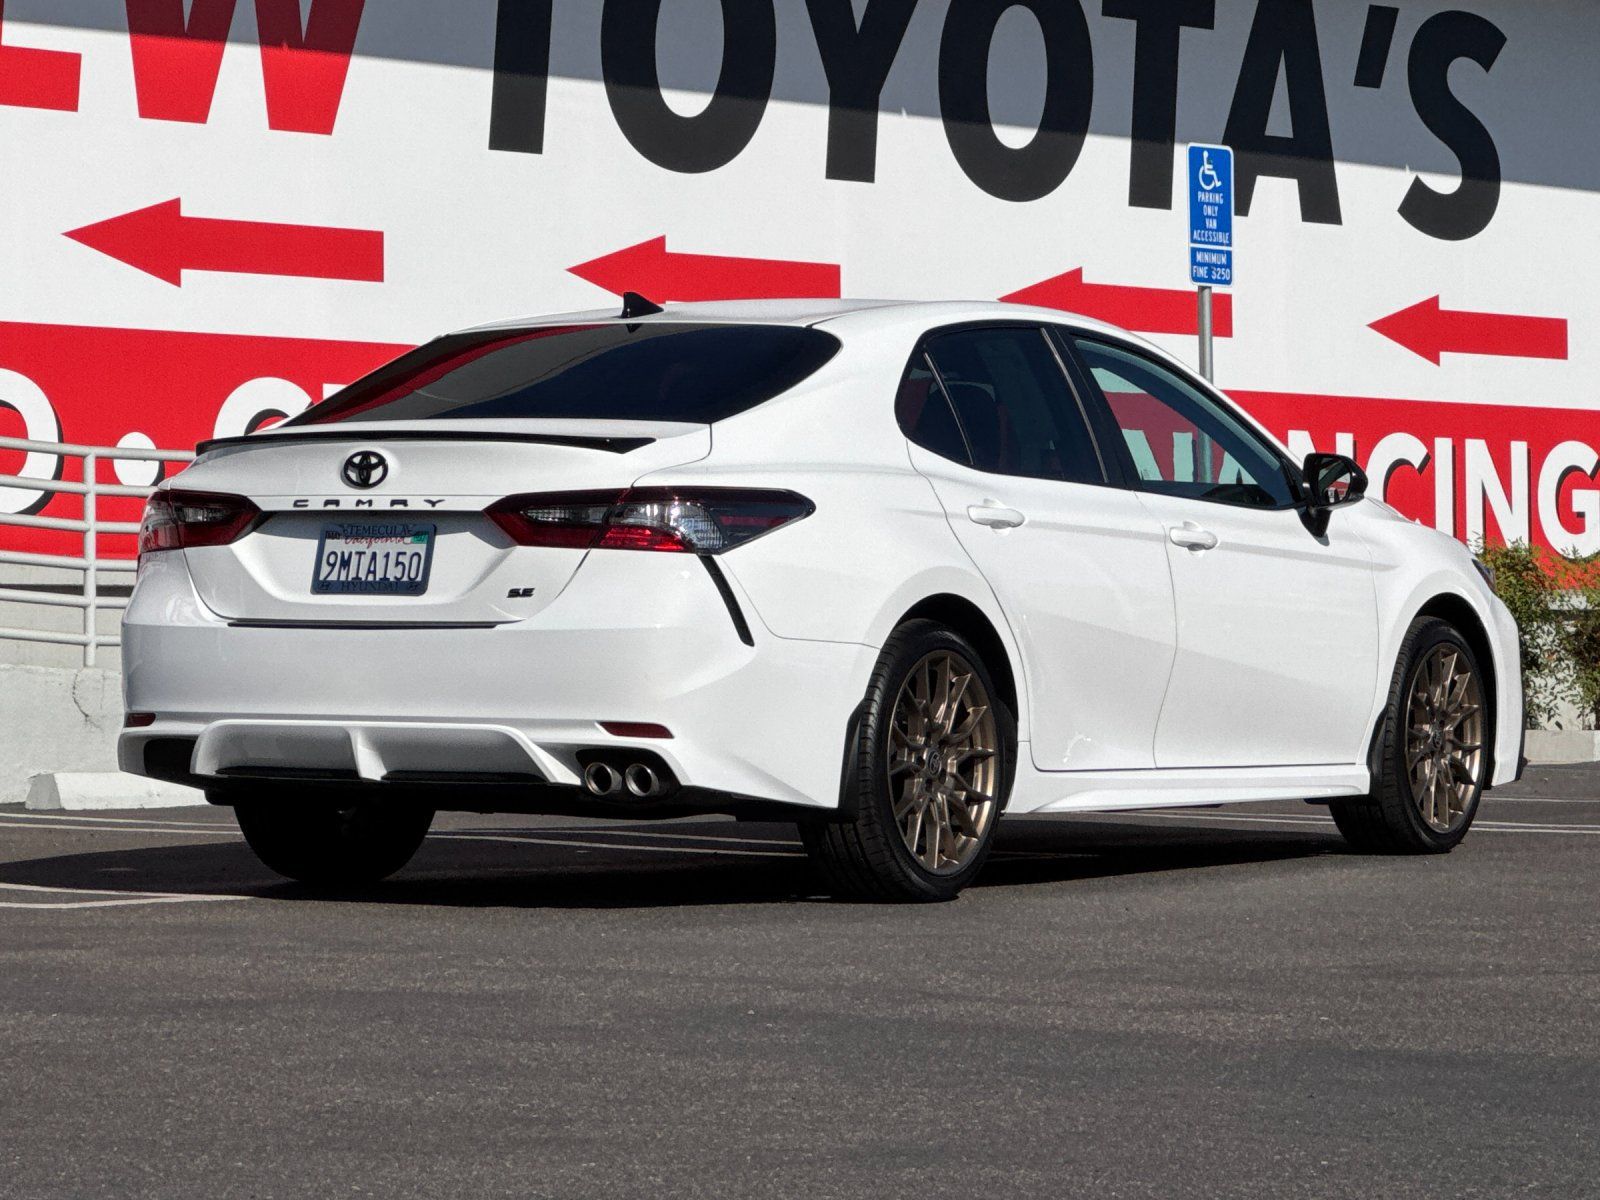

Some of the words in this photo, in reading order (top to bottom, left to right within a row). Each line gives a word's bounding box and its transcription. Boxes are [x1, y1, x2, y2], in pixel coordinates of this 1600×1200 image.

[0, 0, 366, 136] W
[1197, 191, 1224, 204] PARKING
[1203, 205, 1219, 217] ONLY
[1205, 218, 1218, 230] VAN
[1193, 230, 1230, 244] ACCESSIBLE
[1196, 251, 1227, 265] MINIMUM
[1192, 267, 1209, 279] FINE
[1211, 267, 1231, 281] $250
[292, 498, 446, 509] CAMRY
[324, 550, 423, 581] 9MIA150
[506, 587, 535, 599] SE
